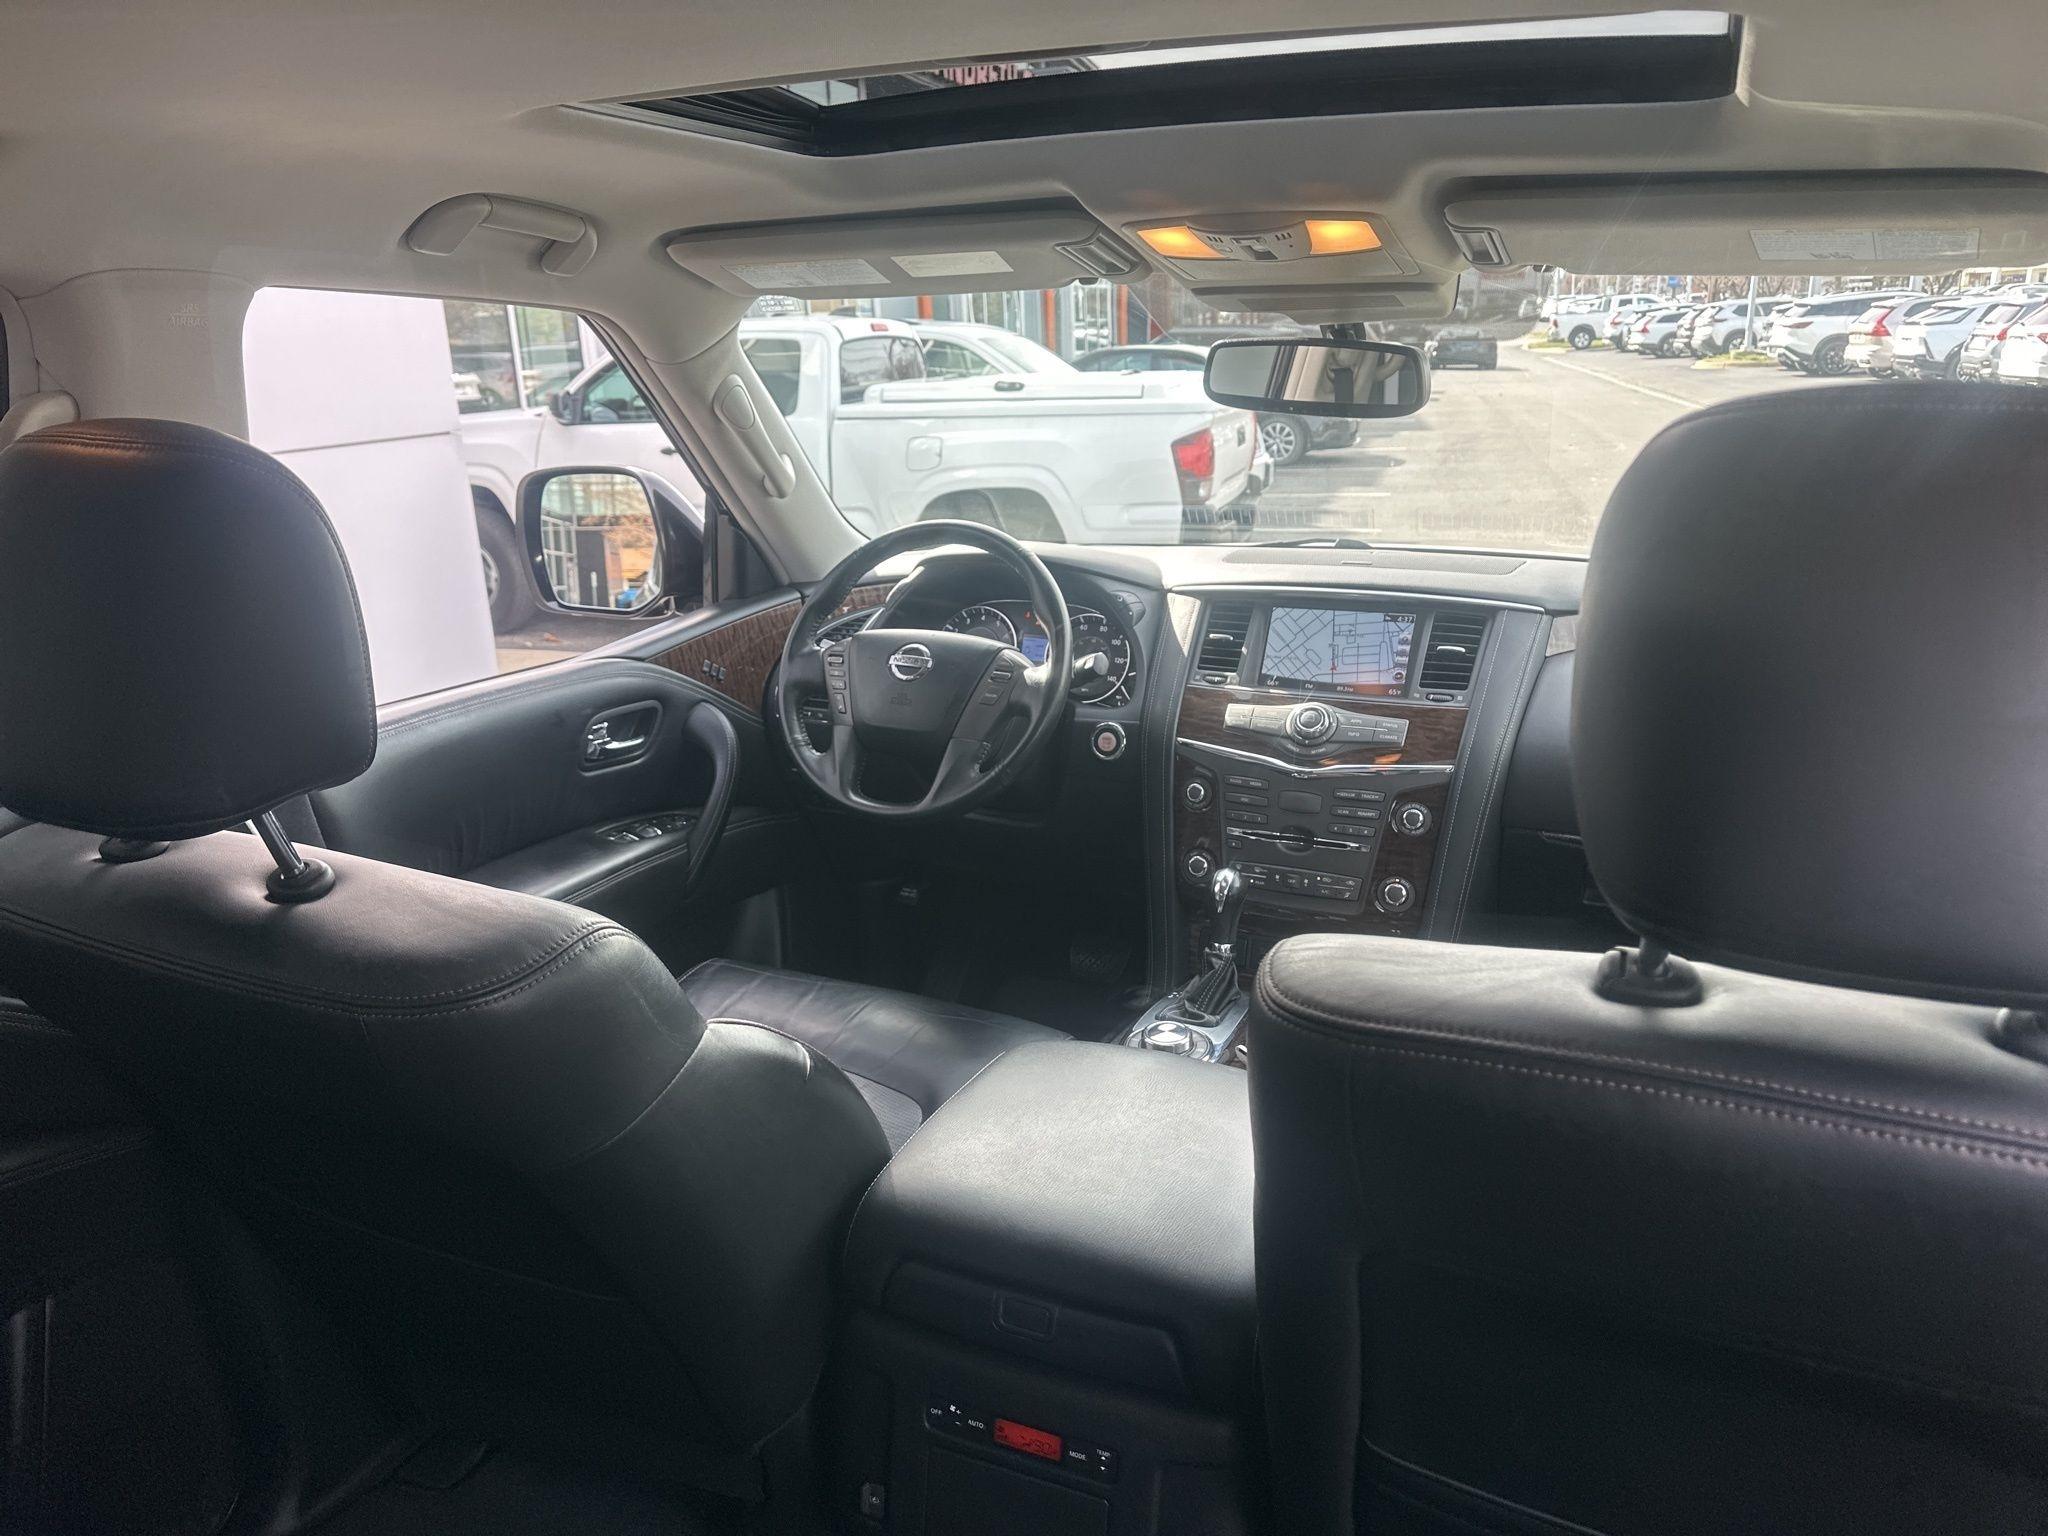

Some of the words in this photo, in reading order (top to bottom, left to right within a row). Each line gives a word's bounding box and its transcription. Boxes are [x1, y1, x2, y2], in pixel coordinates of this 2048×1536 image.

[1099, 625, 1108, 633] 80
[1107, 675, 1117, 683] 140
[930, 1407, 942, 1415] OFF
[967, 1419, 984, 1429] AUTO
[1069, 1450, 1086, 1461] MODE
[1096, 1448, 1111, 1457] TEMP
